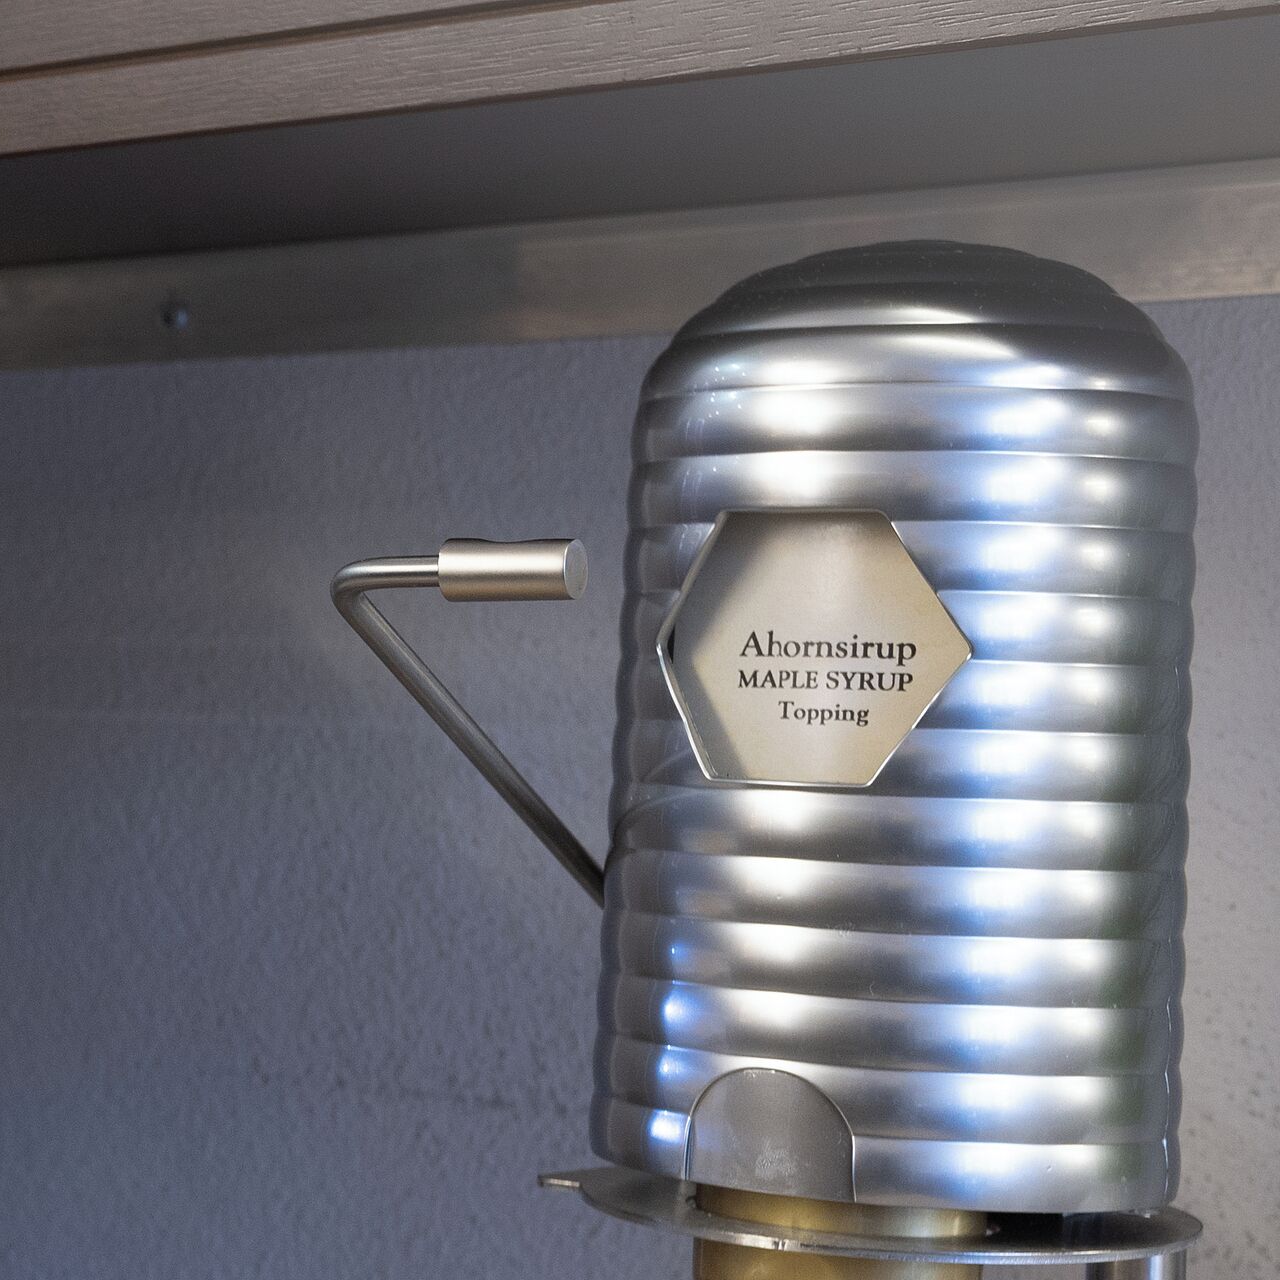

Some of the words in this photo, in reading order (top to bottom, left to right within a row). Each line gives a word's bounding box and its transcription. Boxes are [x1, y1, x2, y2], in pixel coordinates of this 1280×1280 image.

[739, 630, 917, 668] Ahornsirup
[738, 670, 818, 690] MAPLE
[826, 671, 914, 692] SYRUP
[778, 700, 870, 726] Topping
